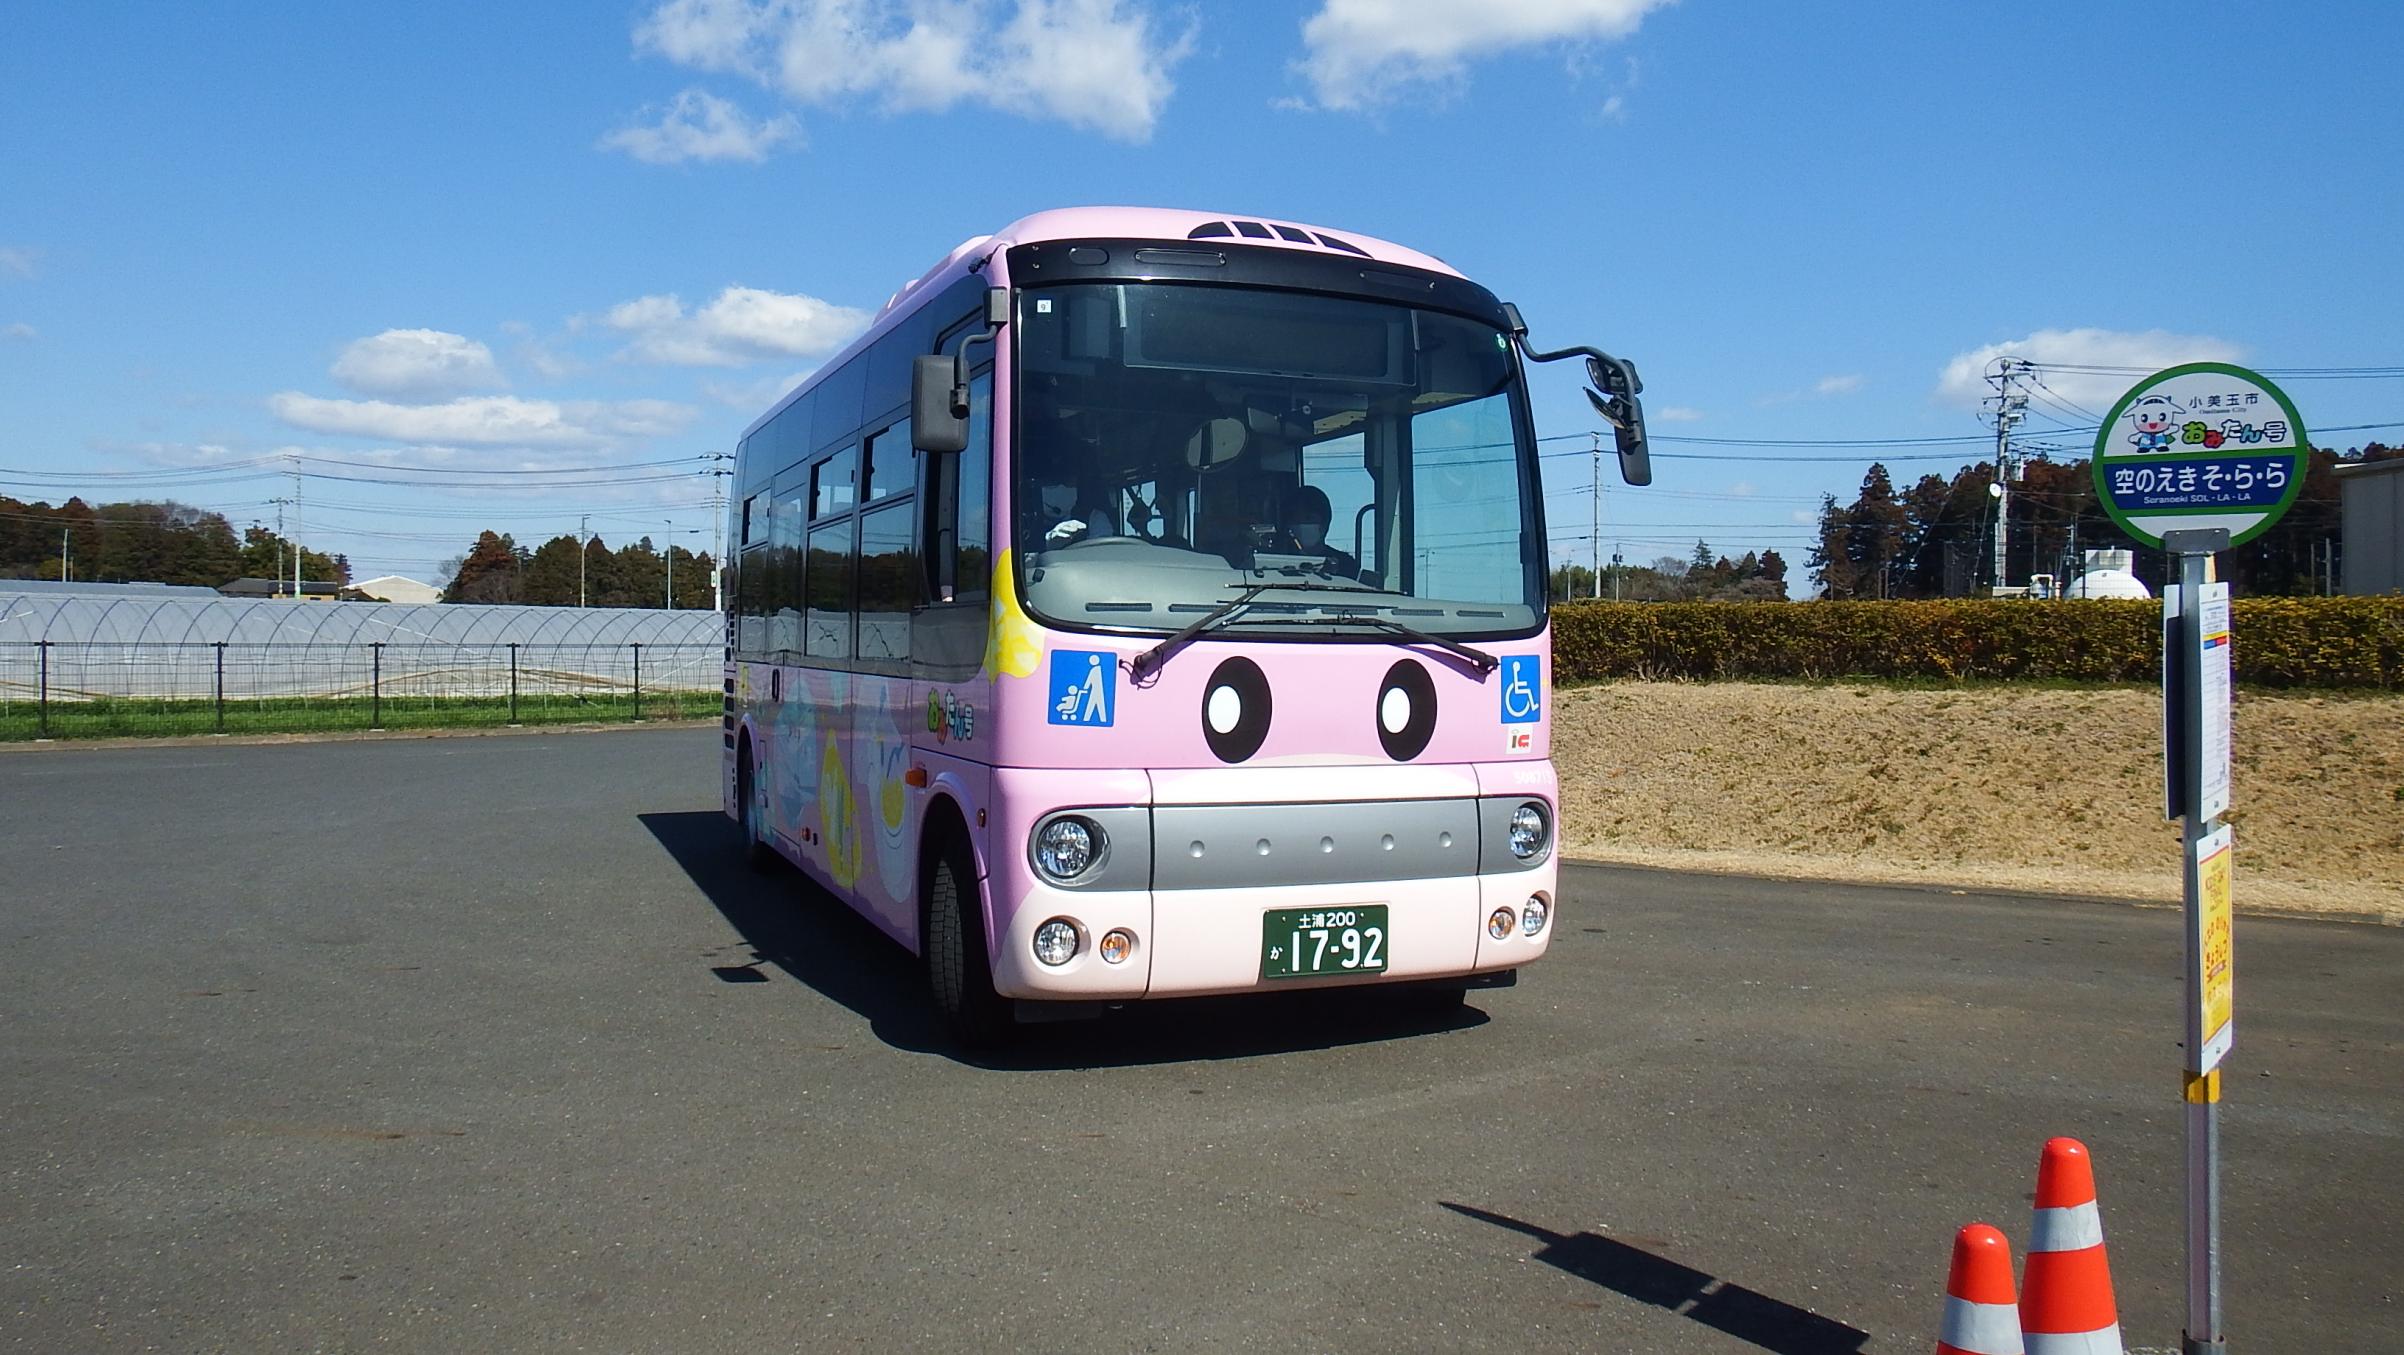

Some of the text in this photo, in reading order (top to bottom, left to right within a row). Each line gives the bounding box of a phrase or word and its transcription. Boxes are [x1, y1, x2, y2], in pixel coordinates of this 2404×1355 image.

[2188, 393, 2260, 409] 小美玉市
[2181, 419, 2287, 449] おみたん号
[1298, 911, 1356, 929] 土浦200
[1270, 927, 1383, 972] か 17-92
